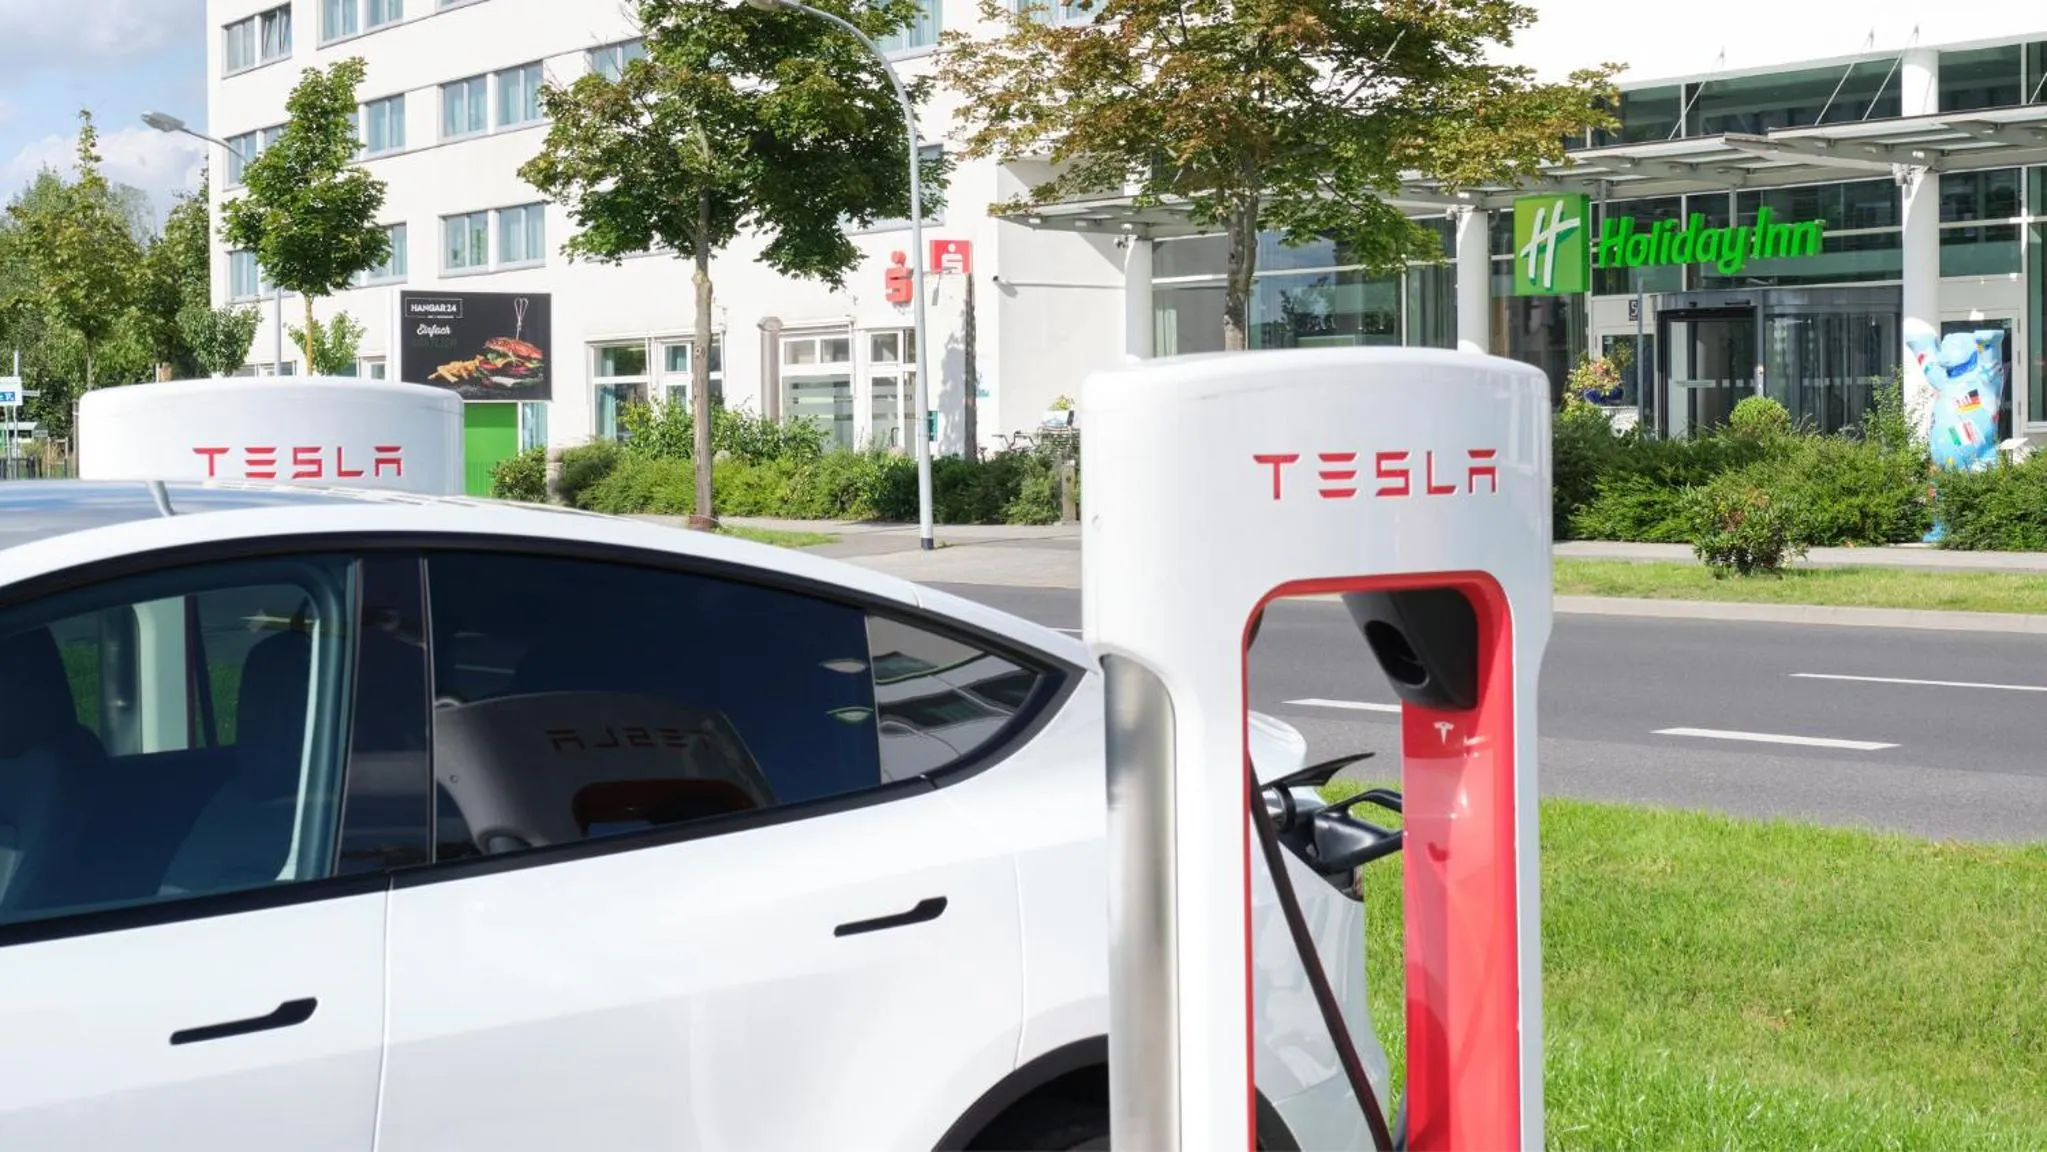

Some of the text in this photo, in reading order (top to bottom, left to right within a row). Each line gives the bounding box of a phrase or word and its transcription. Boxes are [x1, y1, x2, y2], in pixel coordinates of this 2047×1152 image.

[1598, 206, 1826, 275] Holiday Inn
[191, 446, 402, 479] TESLA
[1252, 448, 1497, 501] TESLA
